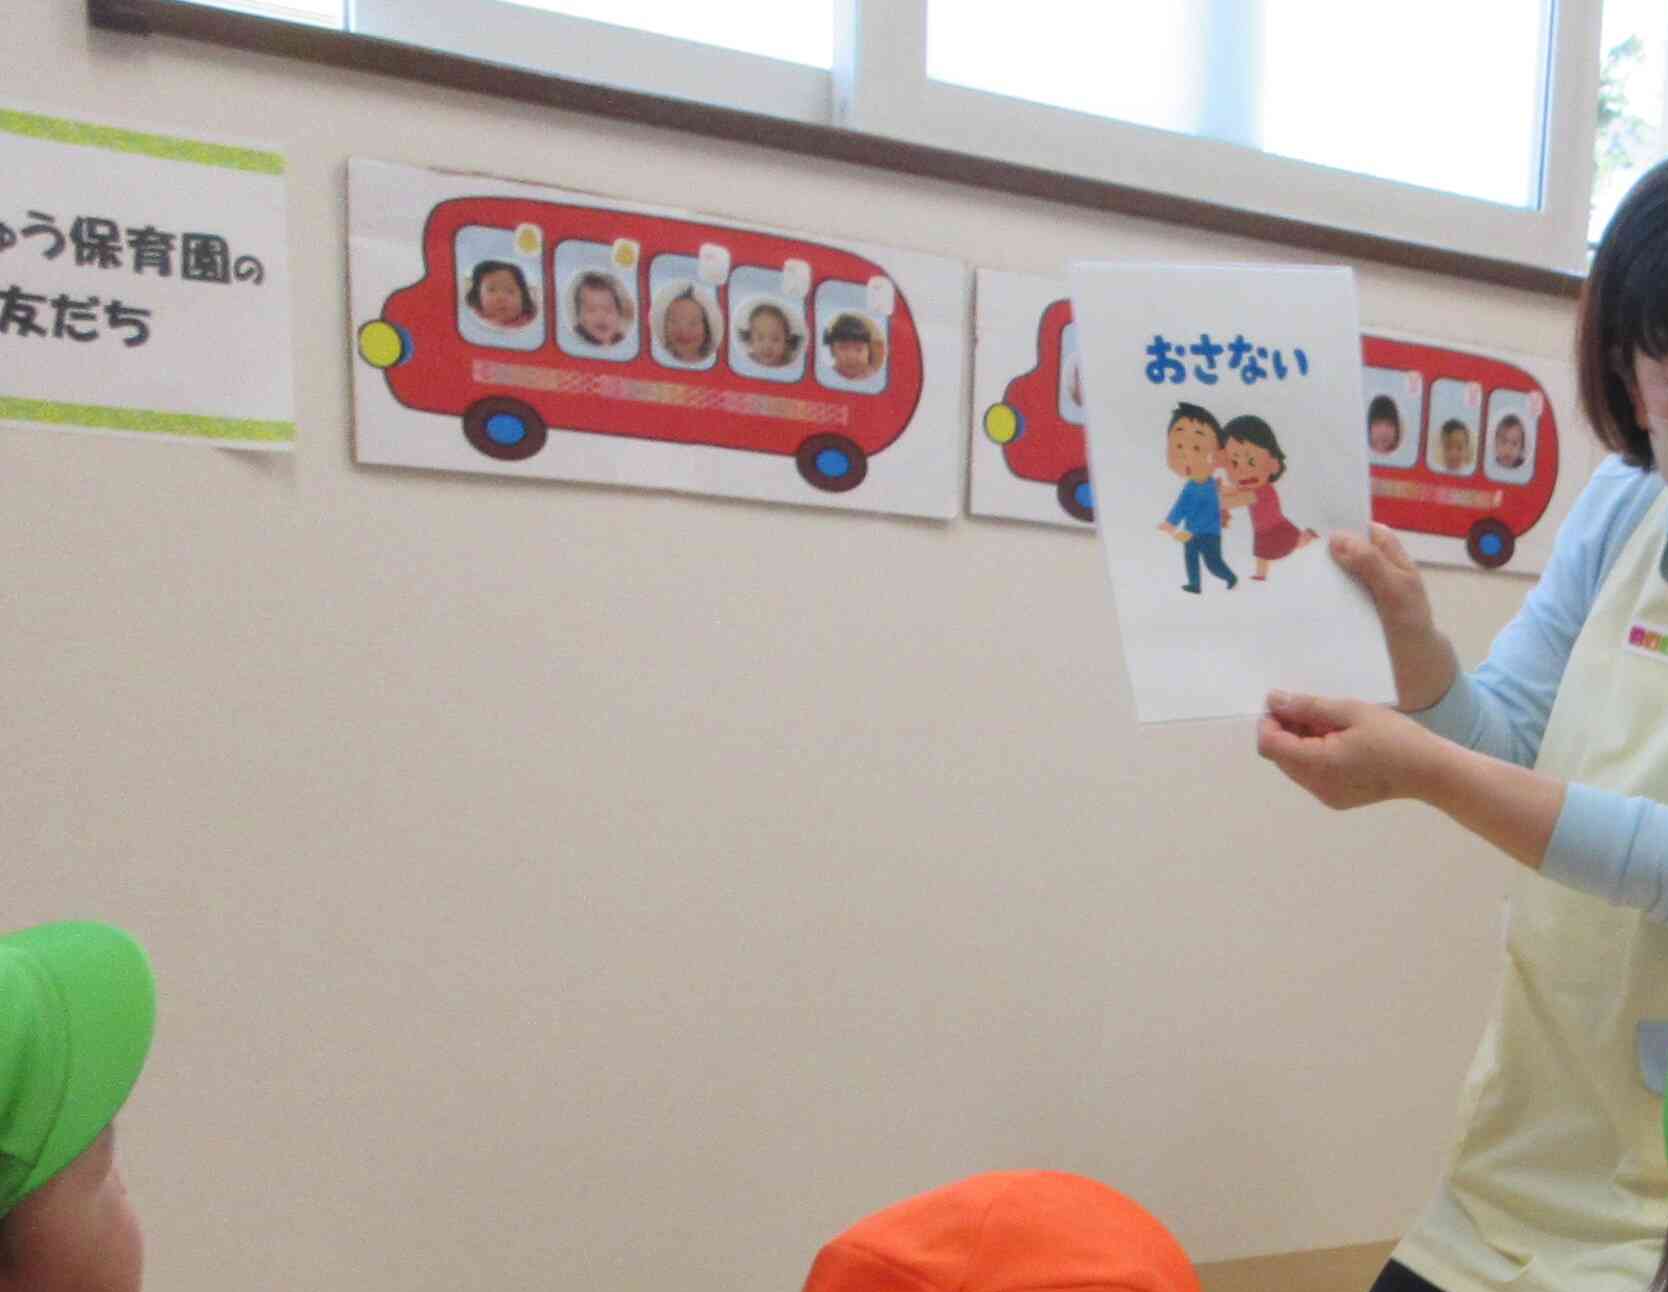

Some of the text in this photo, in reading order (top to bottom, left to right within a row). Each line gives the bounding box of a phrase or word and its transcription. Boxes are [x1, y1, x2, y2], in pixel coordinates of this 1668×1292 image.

[0, 285, 151, 348] 友だち
[1145, 333, 1310, 385] おさない
